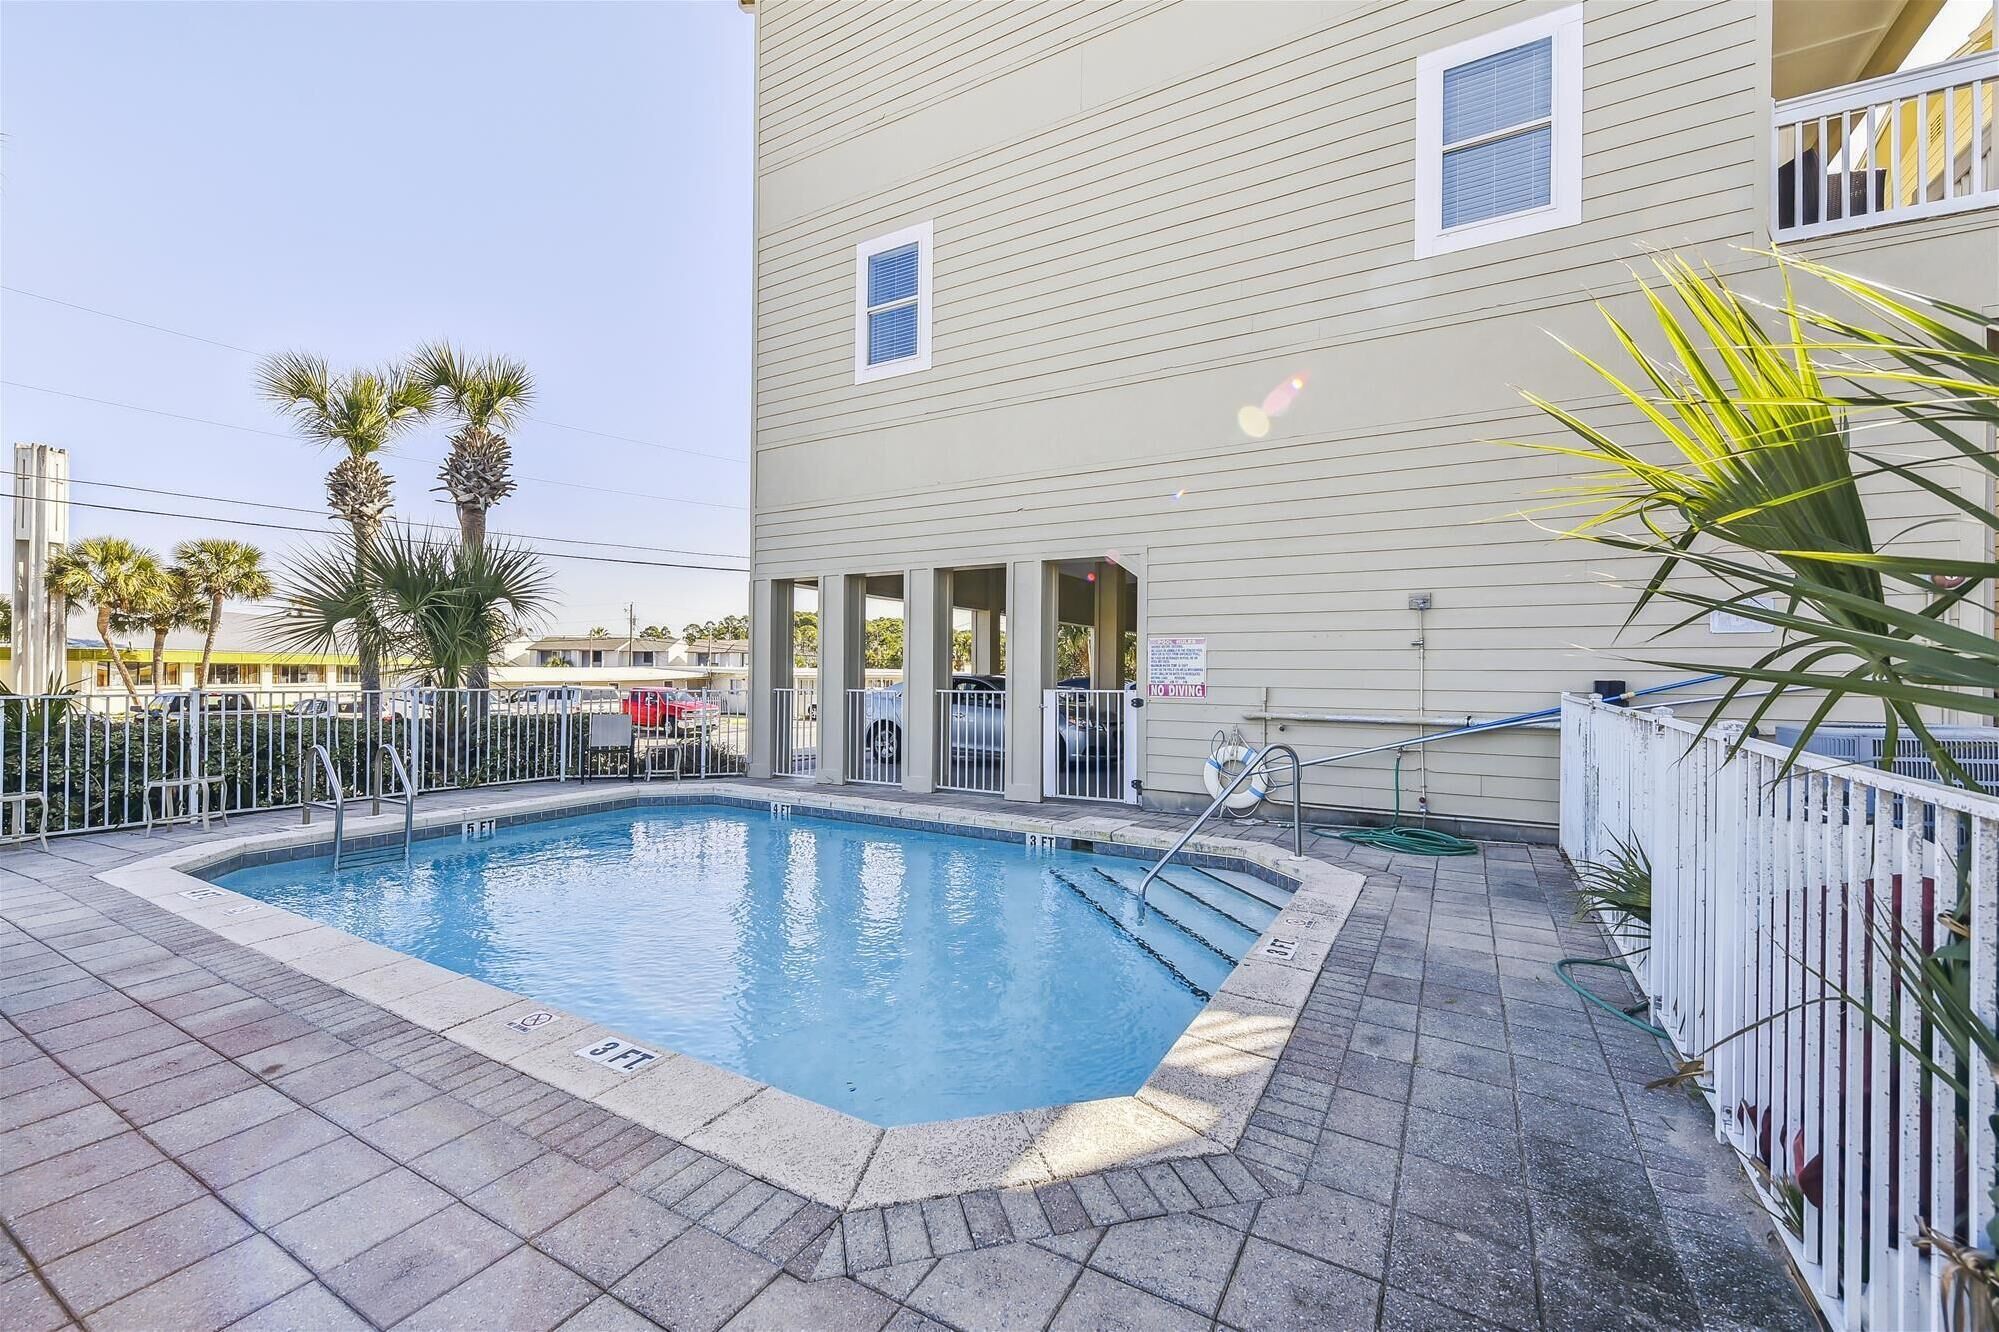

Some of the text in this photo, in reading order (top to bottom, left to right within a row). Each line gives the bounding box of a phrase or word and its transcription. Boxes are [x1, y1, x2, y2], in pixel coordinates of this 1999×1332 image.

[1151, 684, 1203, 697] NO DIVING
[772, 803, 791, 815] 4 FT
[467, 820, 494, 833] 5 FT
[1030, 835, 1054, 848] 3 FT
[1270, 938, 1295, 950] FT
[589, 1042, 655, 1070] 3 FT.
